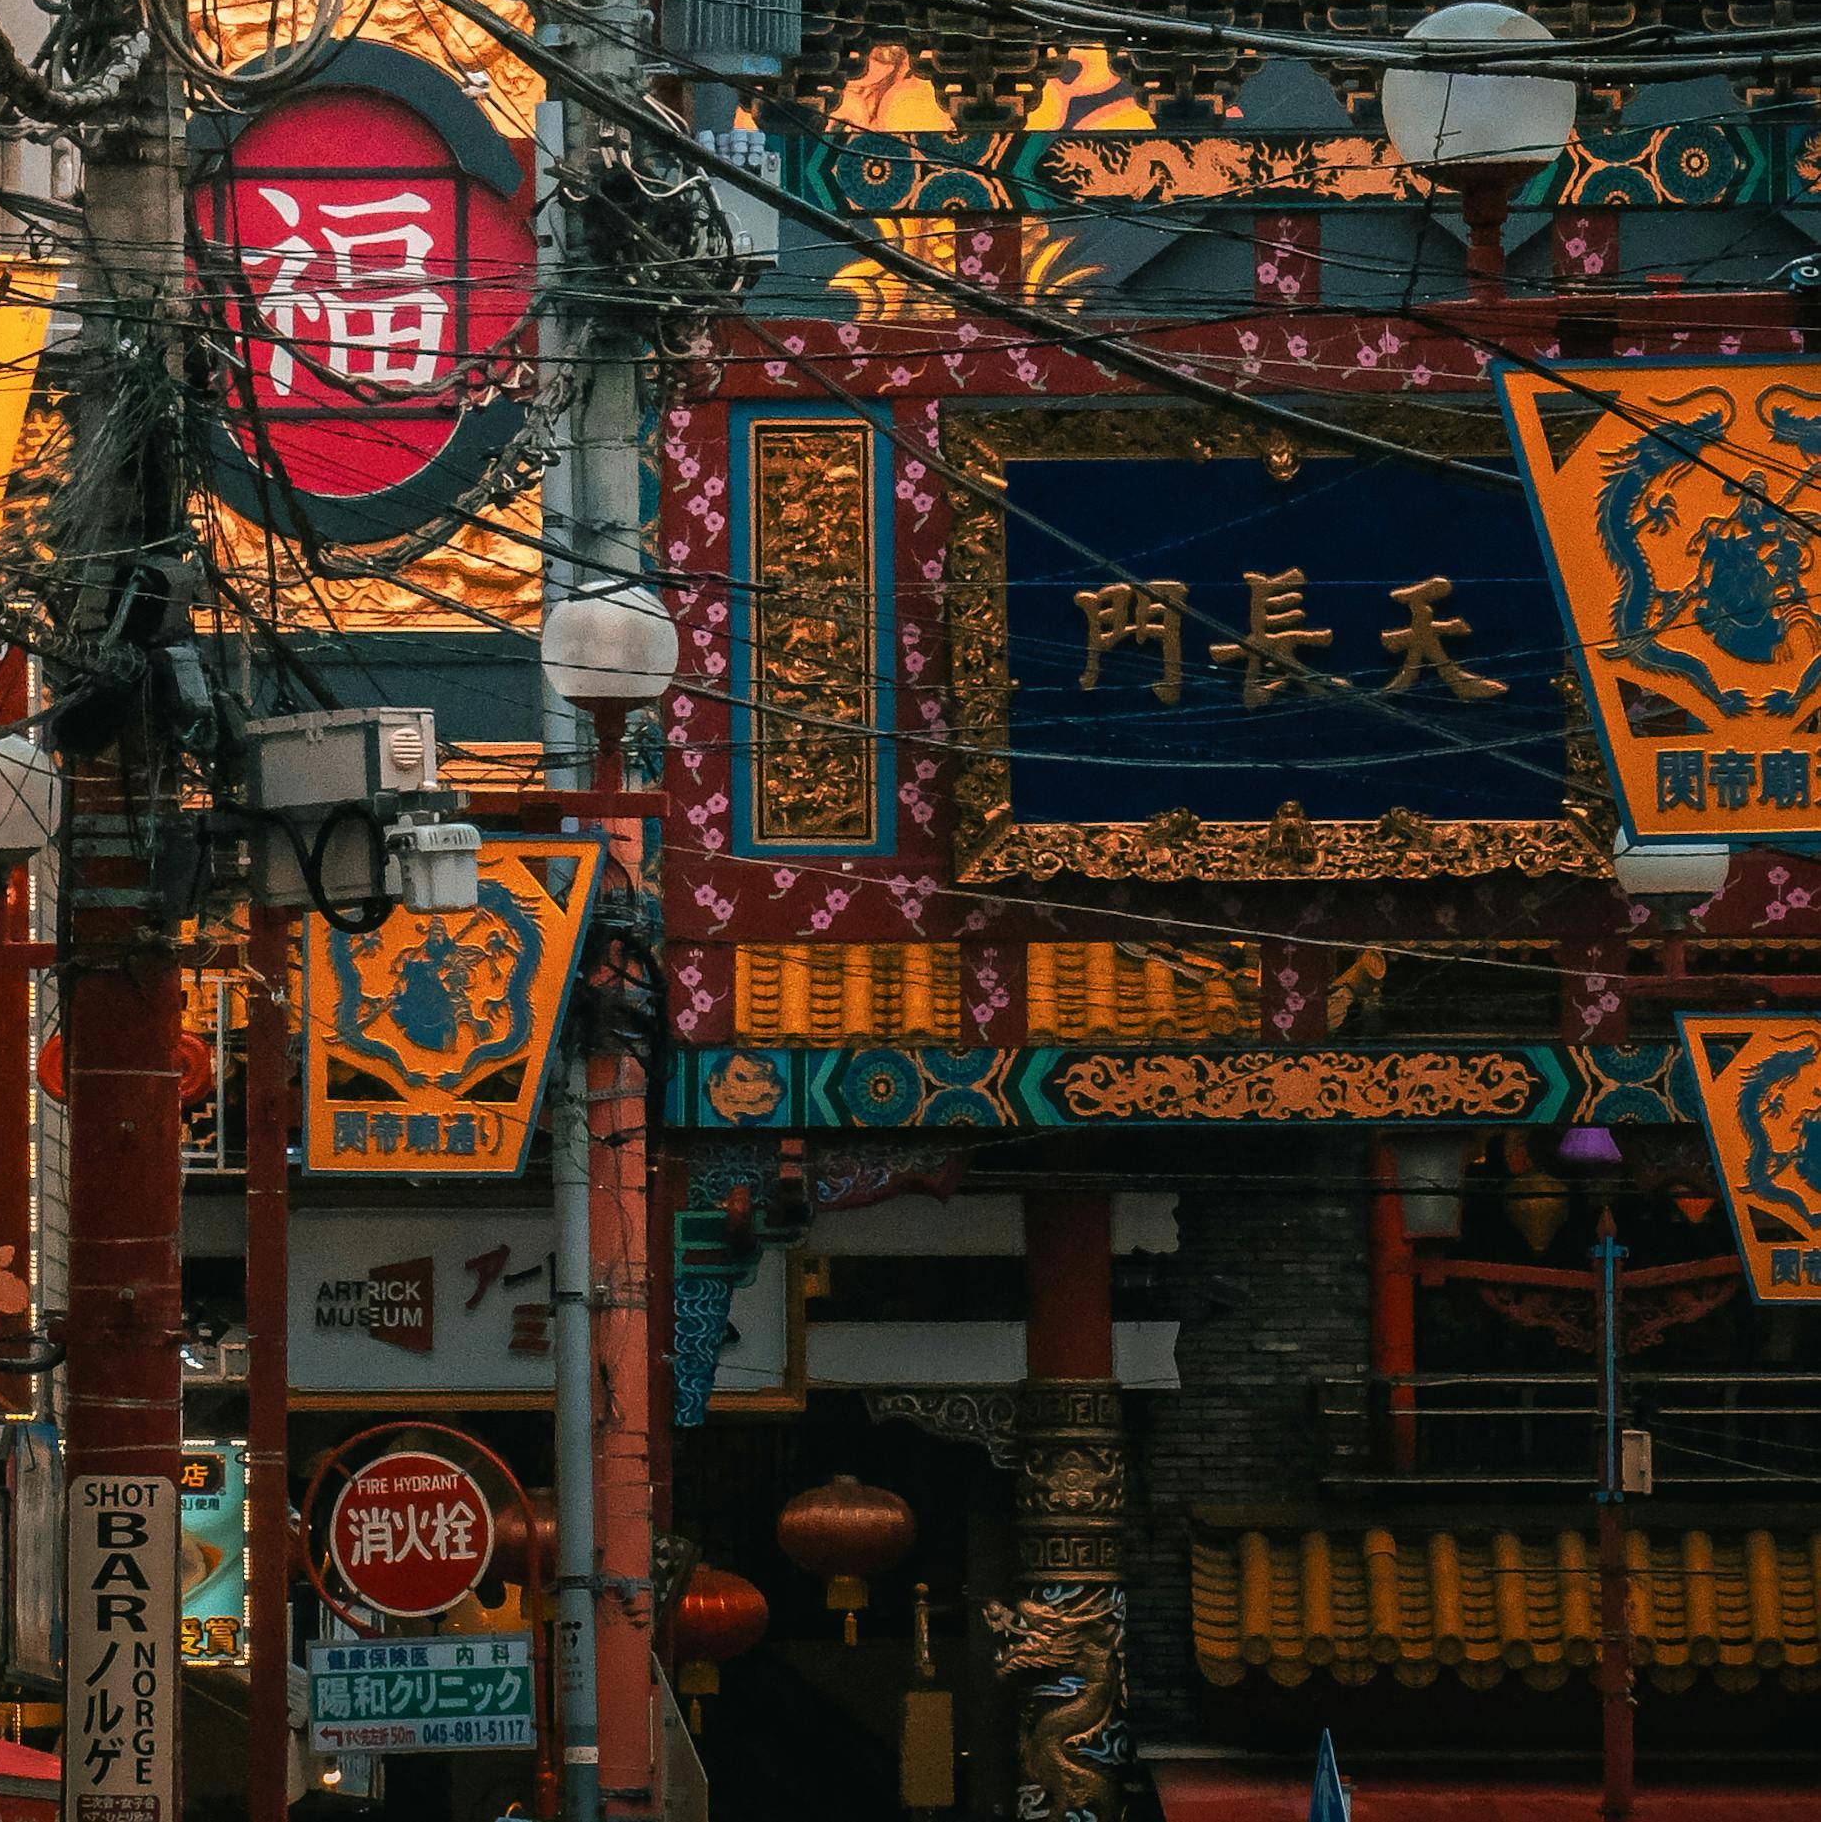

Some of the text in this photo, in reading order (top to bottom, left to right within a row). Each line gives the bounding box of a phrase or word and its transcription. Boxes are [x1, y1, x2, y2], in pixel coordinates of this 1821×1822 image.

[238, 186, 447, 399] 福
[1655, 747, 1821, 812] 関帝廟
[315, 1306, 424, 1328] MUSEUM
[316, 1279, 421, 1302] ARTRICK
[84, 1482, 160, 1508] SHOT
[358, 1473, 460, 1495] FIRE HYDRANT
[346, 1500, 478, 1567] 消火栓
[91, 1511, 151, 1632] BAR
[83, 1641, 126, 1786] ノルゲ
[132, 1641, 157, 1785] NORGE
[316, 1669, 523, 1719] 陽和クリニック
[422, 1719, 525, 1744] 045-681-5117
